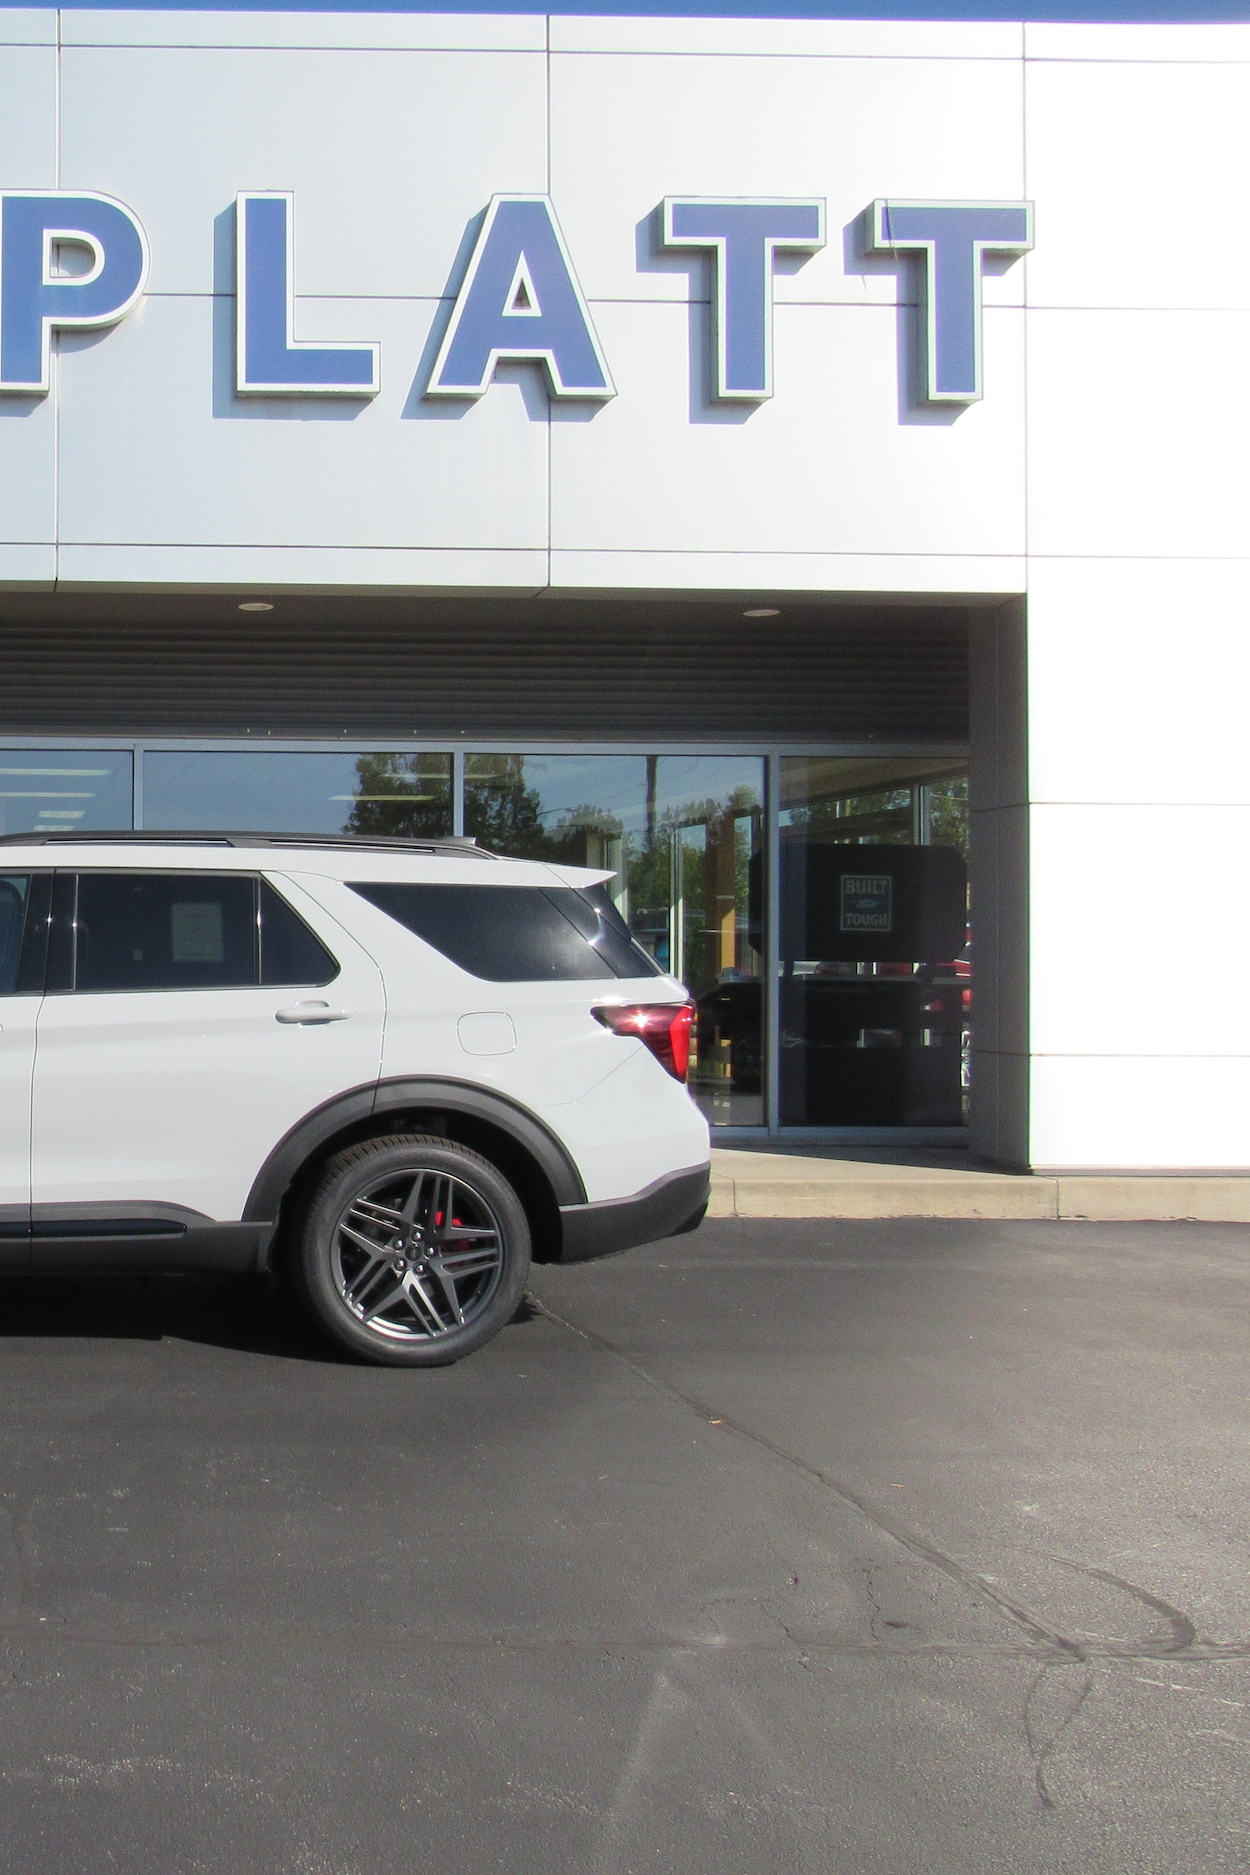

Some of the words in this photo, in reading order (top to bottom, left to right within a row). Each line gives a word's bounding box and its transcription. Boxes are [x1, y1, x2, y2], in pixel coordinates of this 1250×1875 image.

[845, 879, 887, 895] BUILT
[855, 898, 881, 909] Ford
[845, 913, 887, 926] TOUGH
